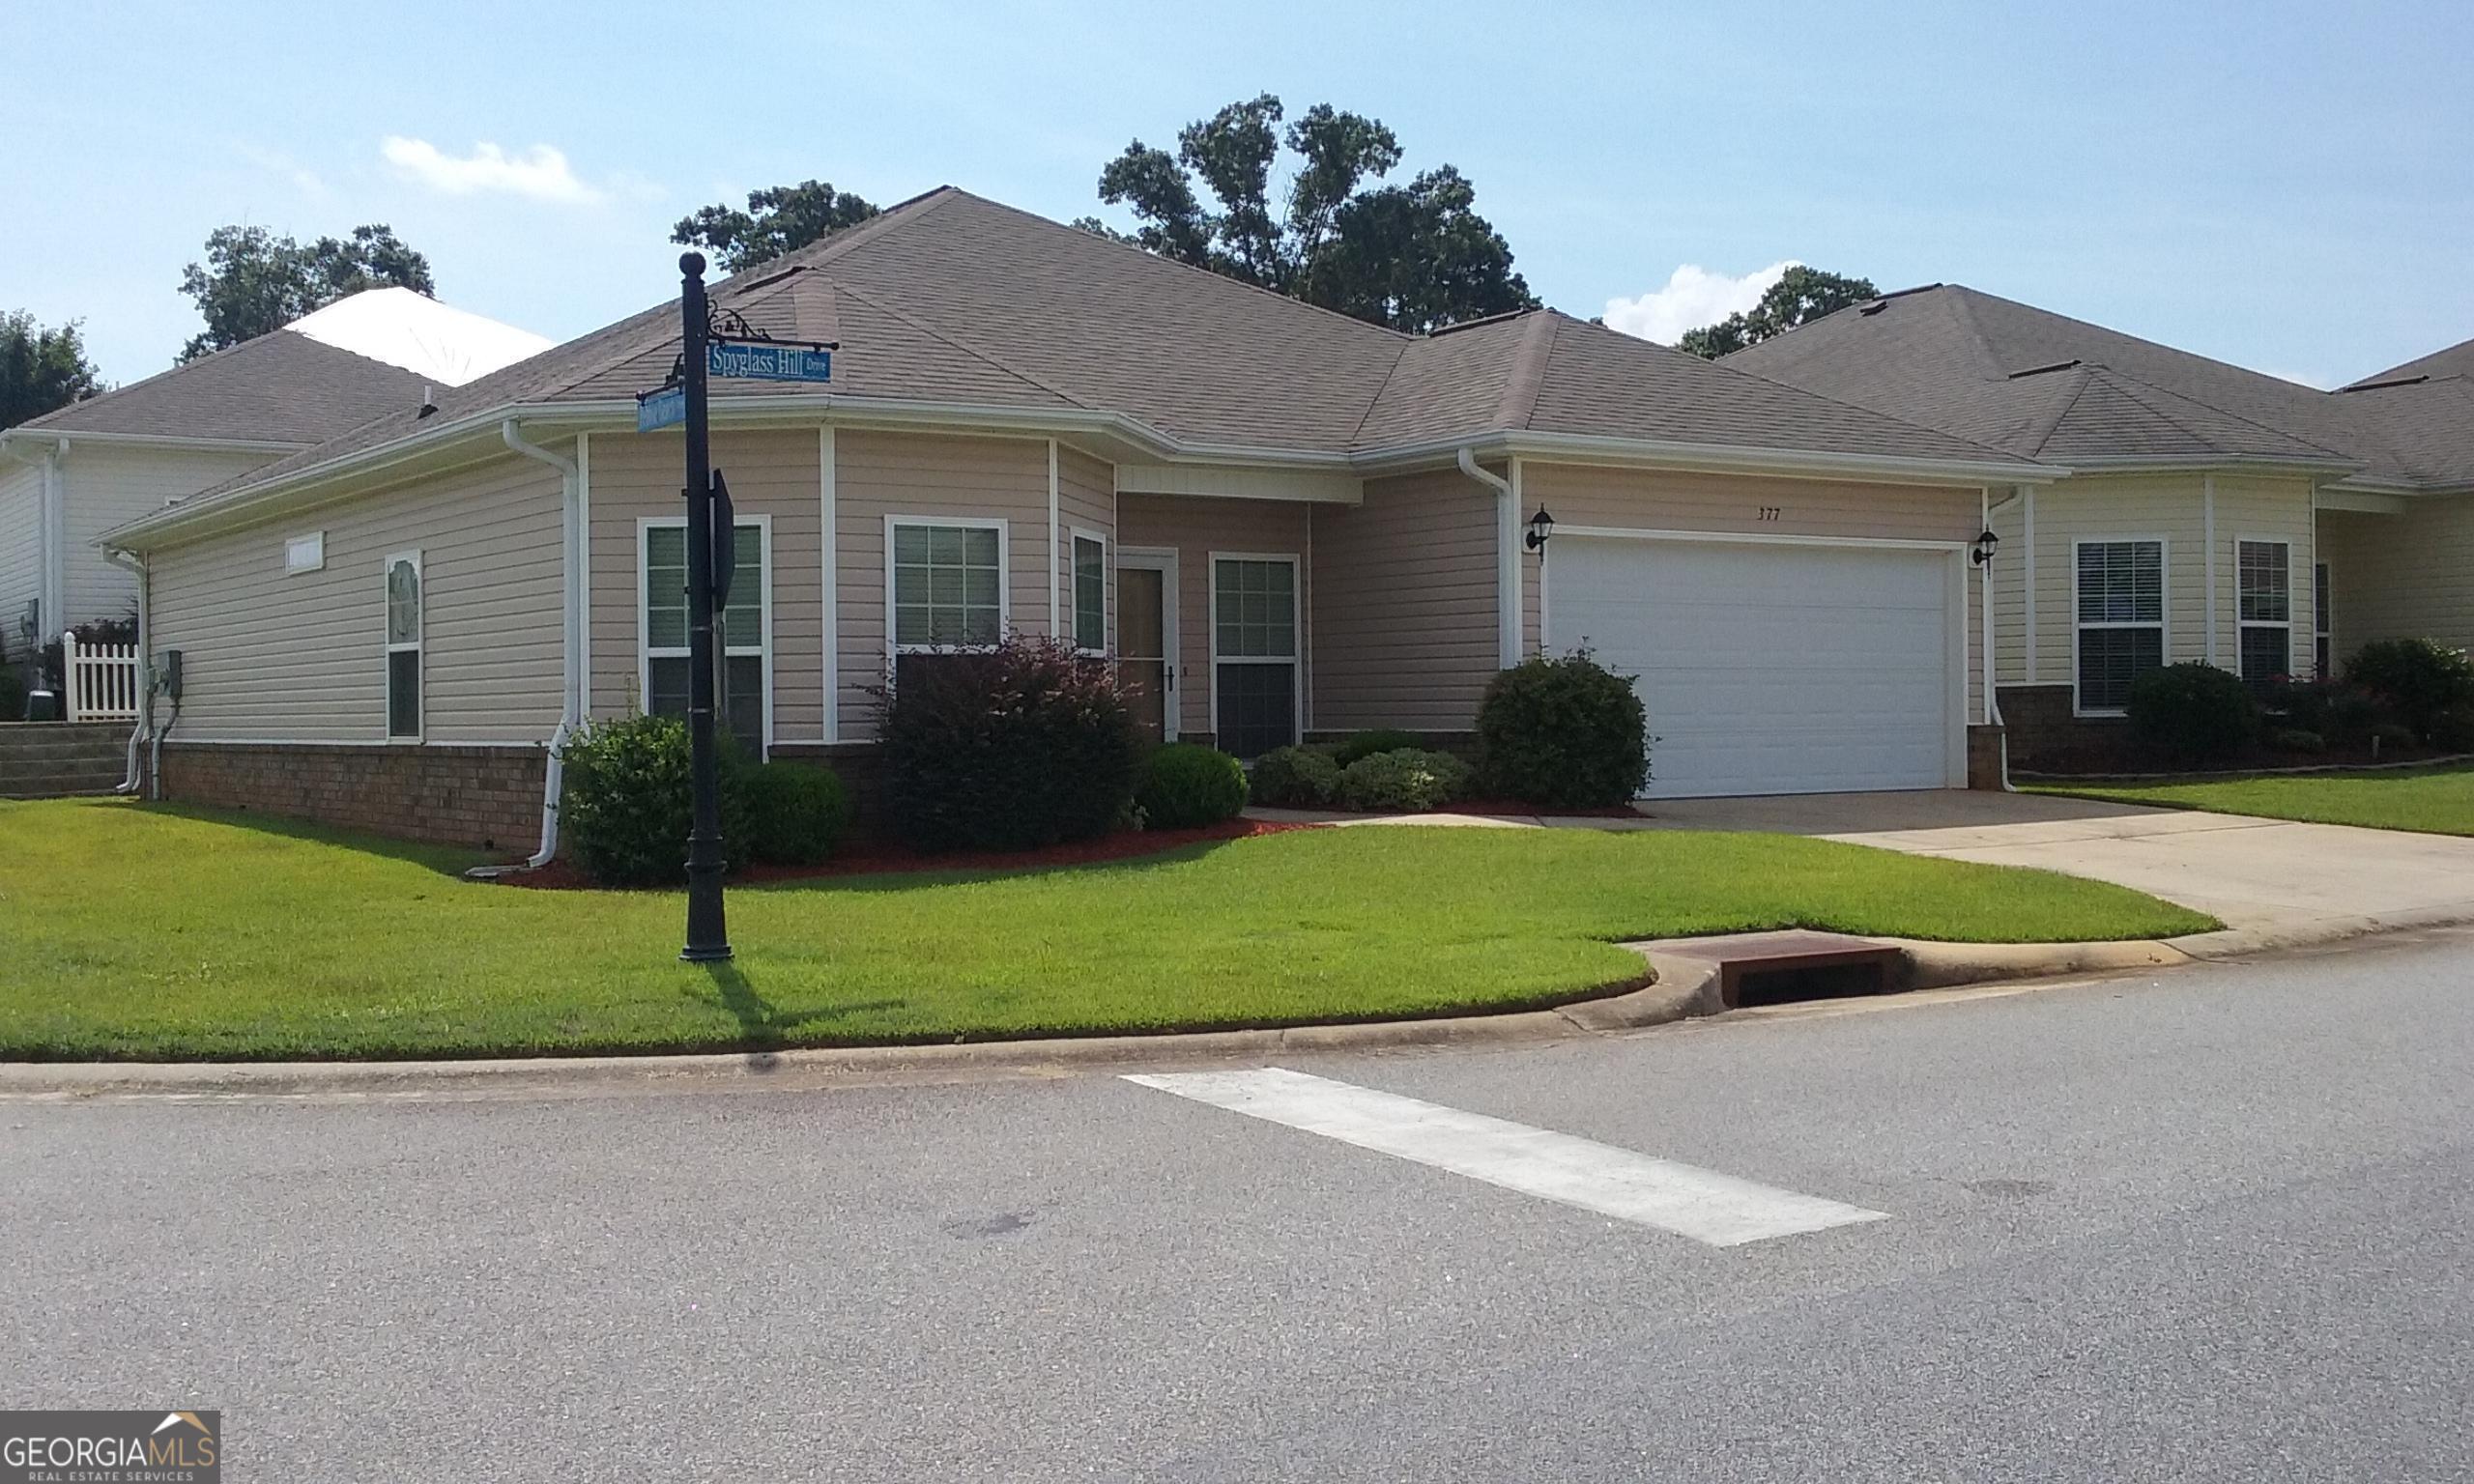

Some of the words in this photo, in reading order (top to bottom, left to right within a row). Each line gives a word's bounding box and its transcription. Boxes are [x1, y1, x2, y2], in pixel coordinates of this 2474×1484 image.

[713, 346, 774, 377] Spyglass
[777, 350, 804, 375] Hill
[806, 357, 826, 372] Drive
[1756, 507, 1780, 521] 377
